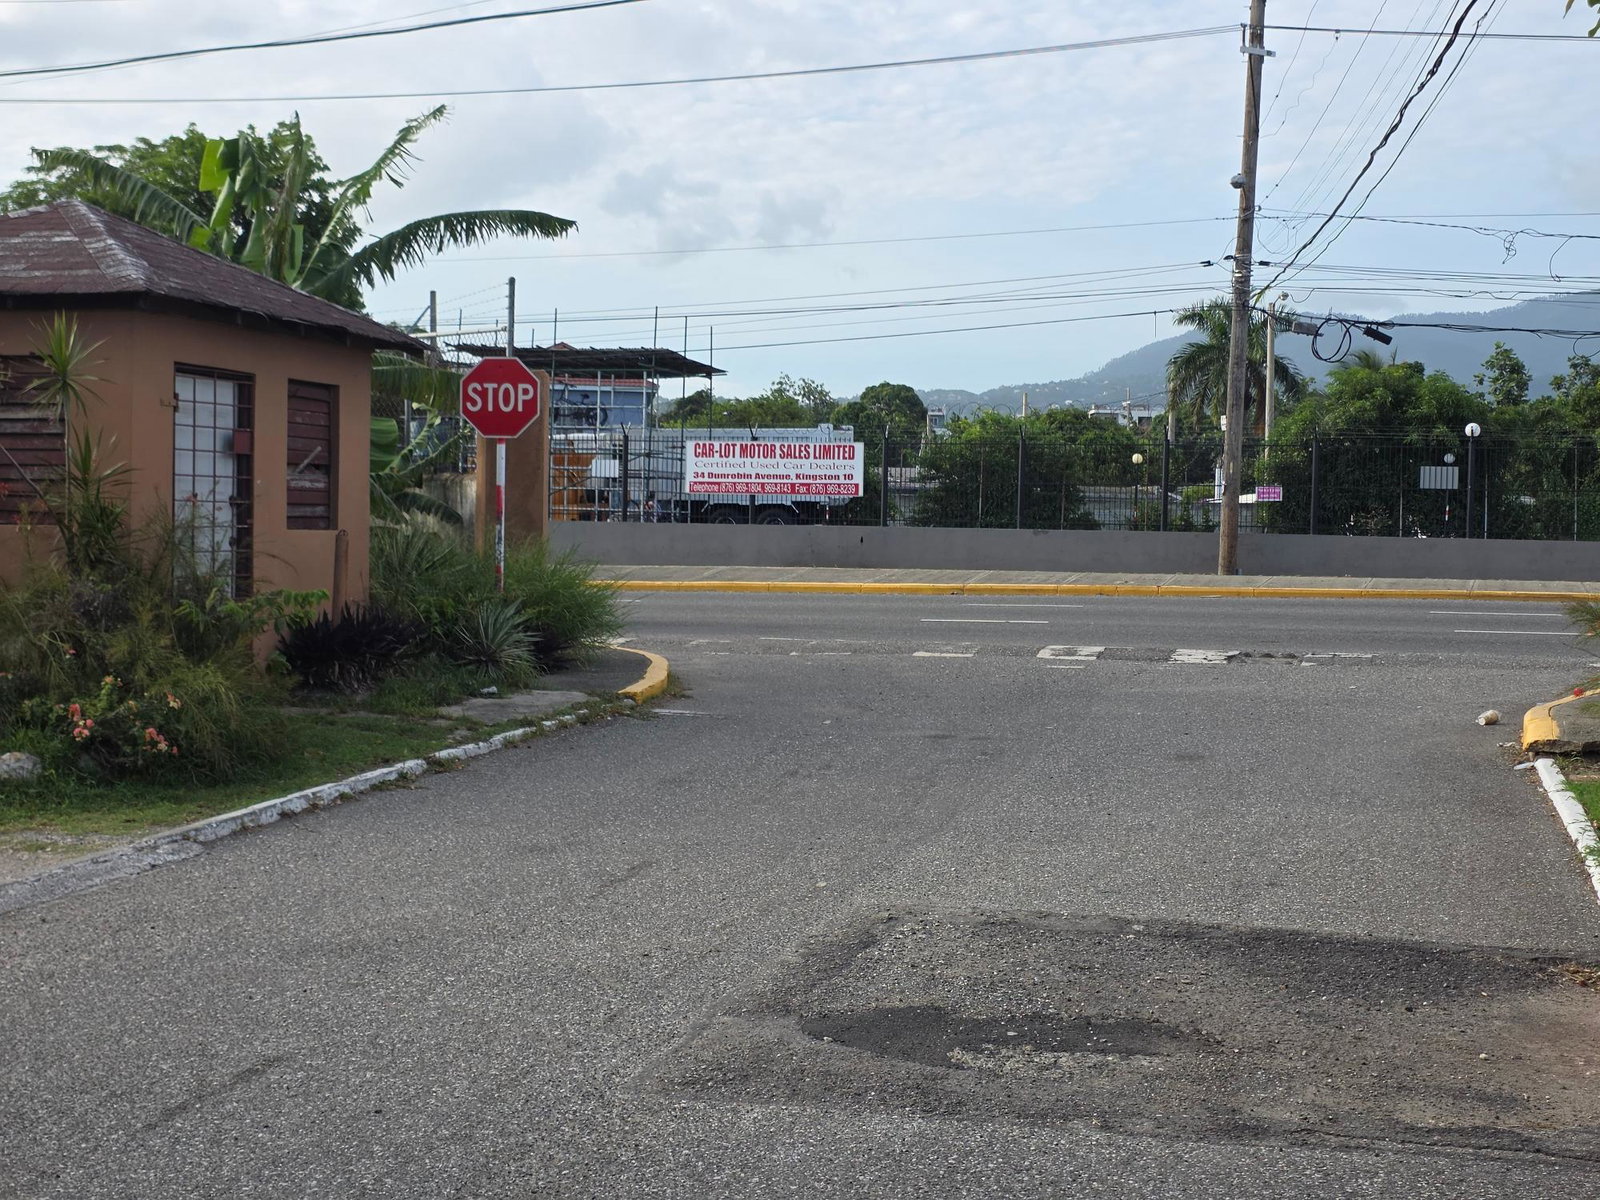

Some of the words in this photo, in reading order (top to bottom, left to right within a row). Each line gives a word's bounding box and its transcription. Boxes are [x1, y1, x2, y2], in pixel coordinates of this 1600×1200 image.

[466, 382, 534, 413] STOP
[694, 442, 737, 459] CAR-LOT
[739, 443, 777, 459] MOTOR
[779, 443, 811, 460] SALES
[813, 444, 855, 461] LIMITED
[694, 460, 746, 469] Certified
[750, 461, 779, 470] Used
[783, 461, 806, 470] Car
[809, 462, 855, 471] Dealers
[693, 471, 705, 479] 34
[707, 472, 752, 480] Dunrobin
[795, 473, 840, 481] Kingston
[843, 473, 854, 481] 10
[690, 482, 719, 493] Telephone
[719, 482, 735, 493] (876)
[764, 483, 791, 494] 969-8143
[809, 484, 826, 495] (876)
[826, 484, 856, 494] 969-8239
